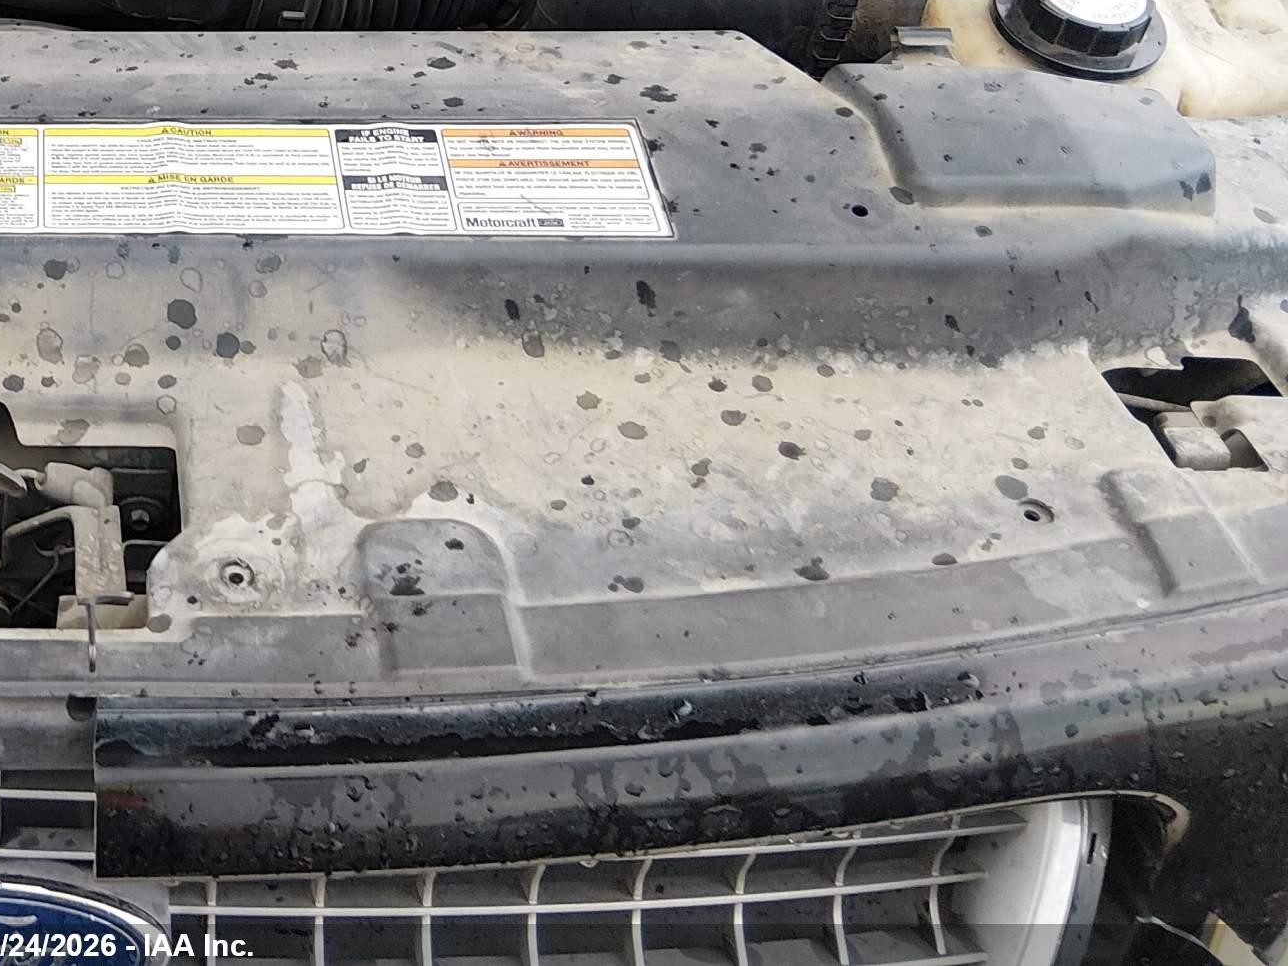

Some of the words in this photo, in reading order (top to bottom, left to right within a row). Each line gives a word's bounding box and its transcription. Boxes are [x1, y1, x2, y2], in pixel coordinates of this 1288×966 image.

[169, 127, 213, 137] CAUTION
[371, 128, 410, 137] ENGINE
[393, 135, 424, 143] START
[465, 217, 536, 228] Motorcraft
